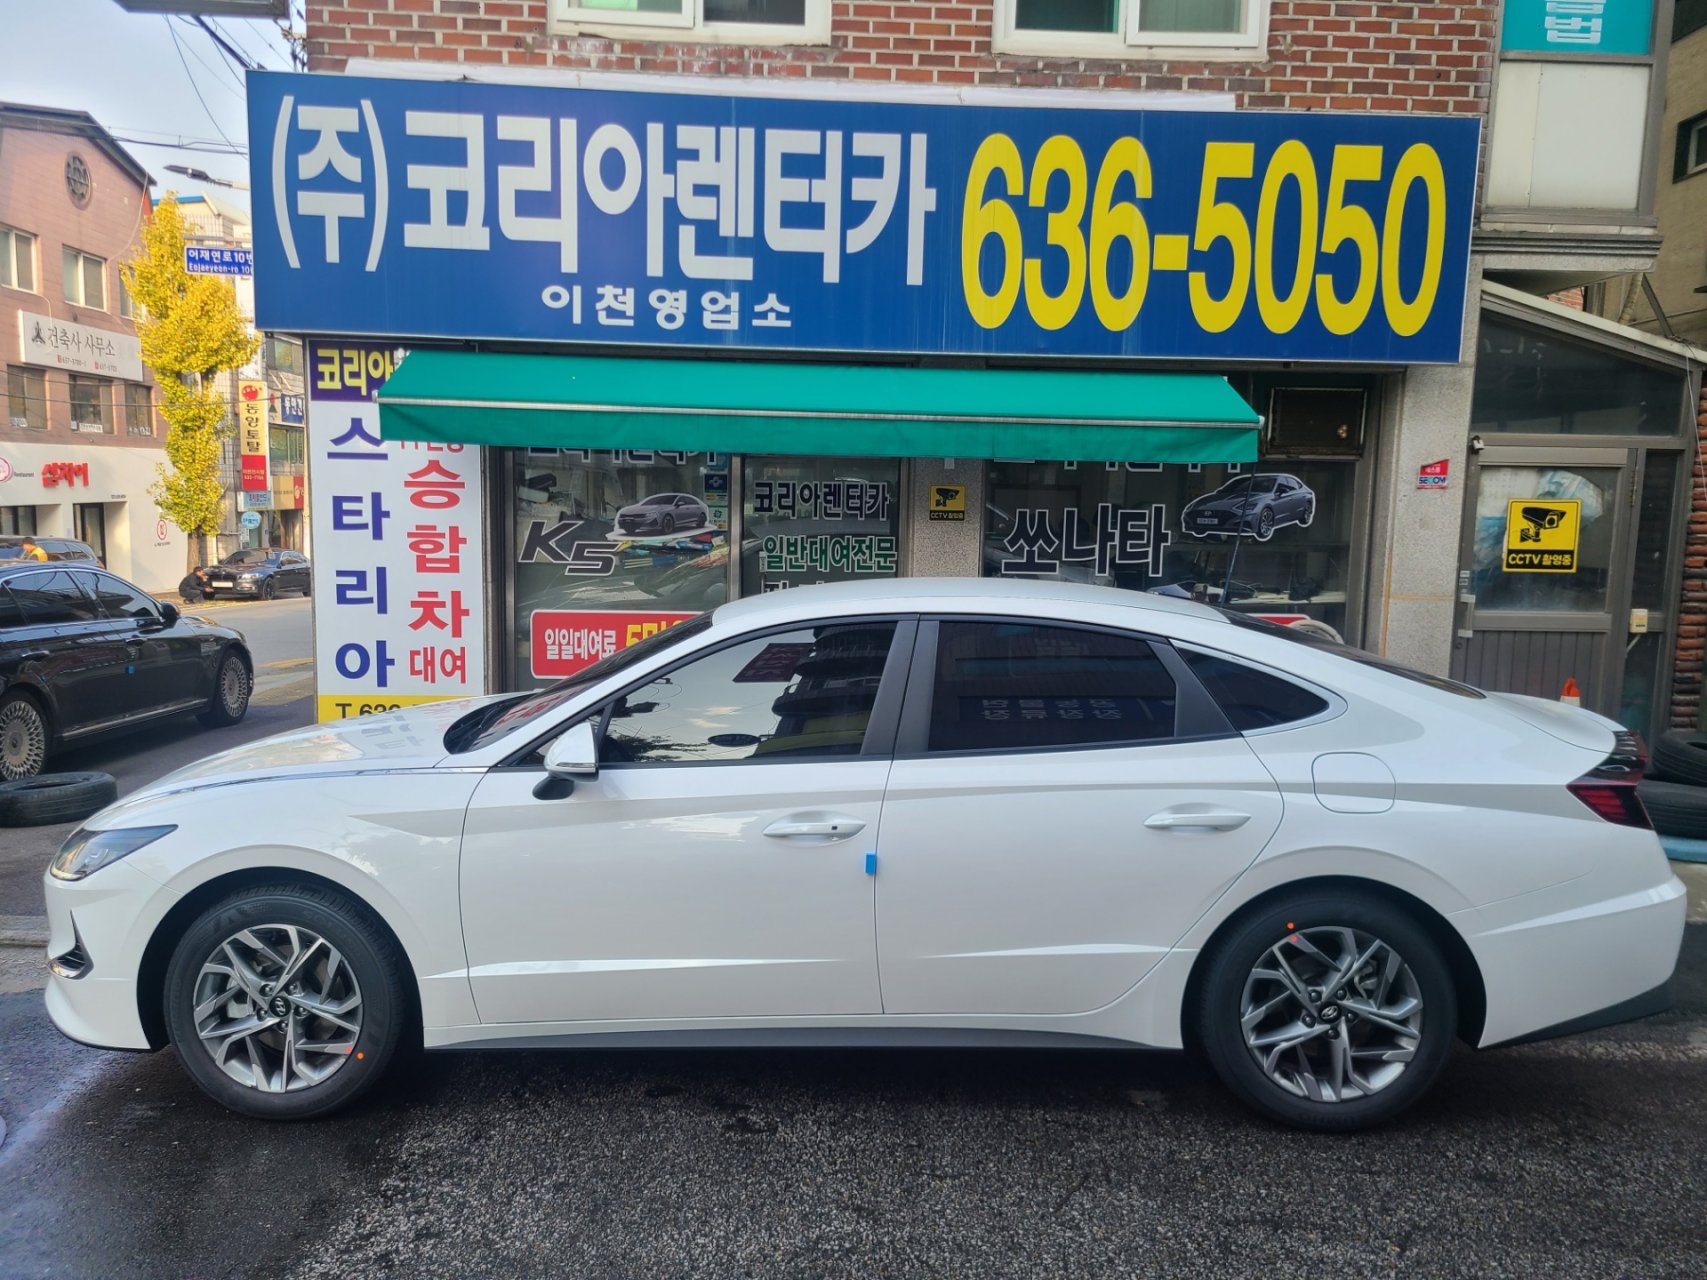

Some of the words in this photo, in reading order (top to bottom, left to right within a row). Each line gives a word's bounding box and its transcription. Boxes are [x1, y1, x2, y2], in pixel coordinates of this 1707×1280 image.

[961, 132, 1447, 337] 636-5050
[84, 333, 116, 357] 사무소
[753, 480, 891, 521] 코리아렌터카
[930, 512, 948, 520] CCTV
[326, 416, 396, 688] 스타리아
[403, 459, 471, 638] 승합차
[518, 520, 622, 577] K5
[762, 534, 898, 573] 일반대여전문
[1001, 503, 1171, 577] 쏘나타
[1508, 553, 1541, 565] CCTV
[408, 646, 468, 684] 대여
